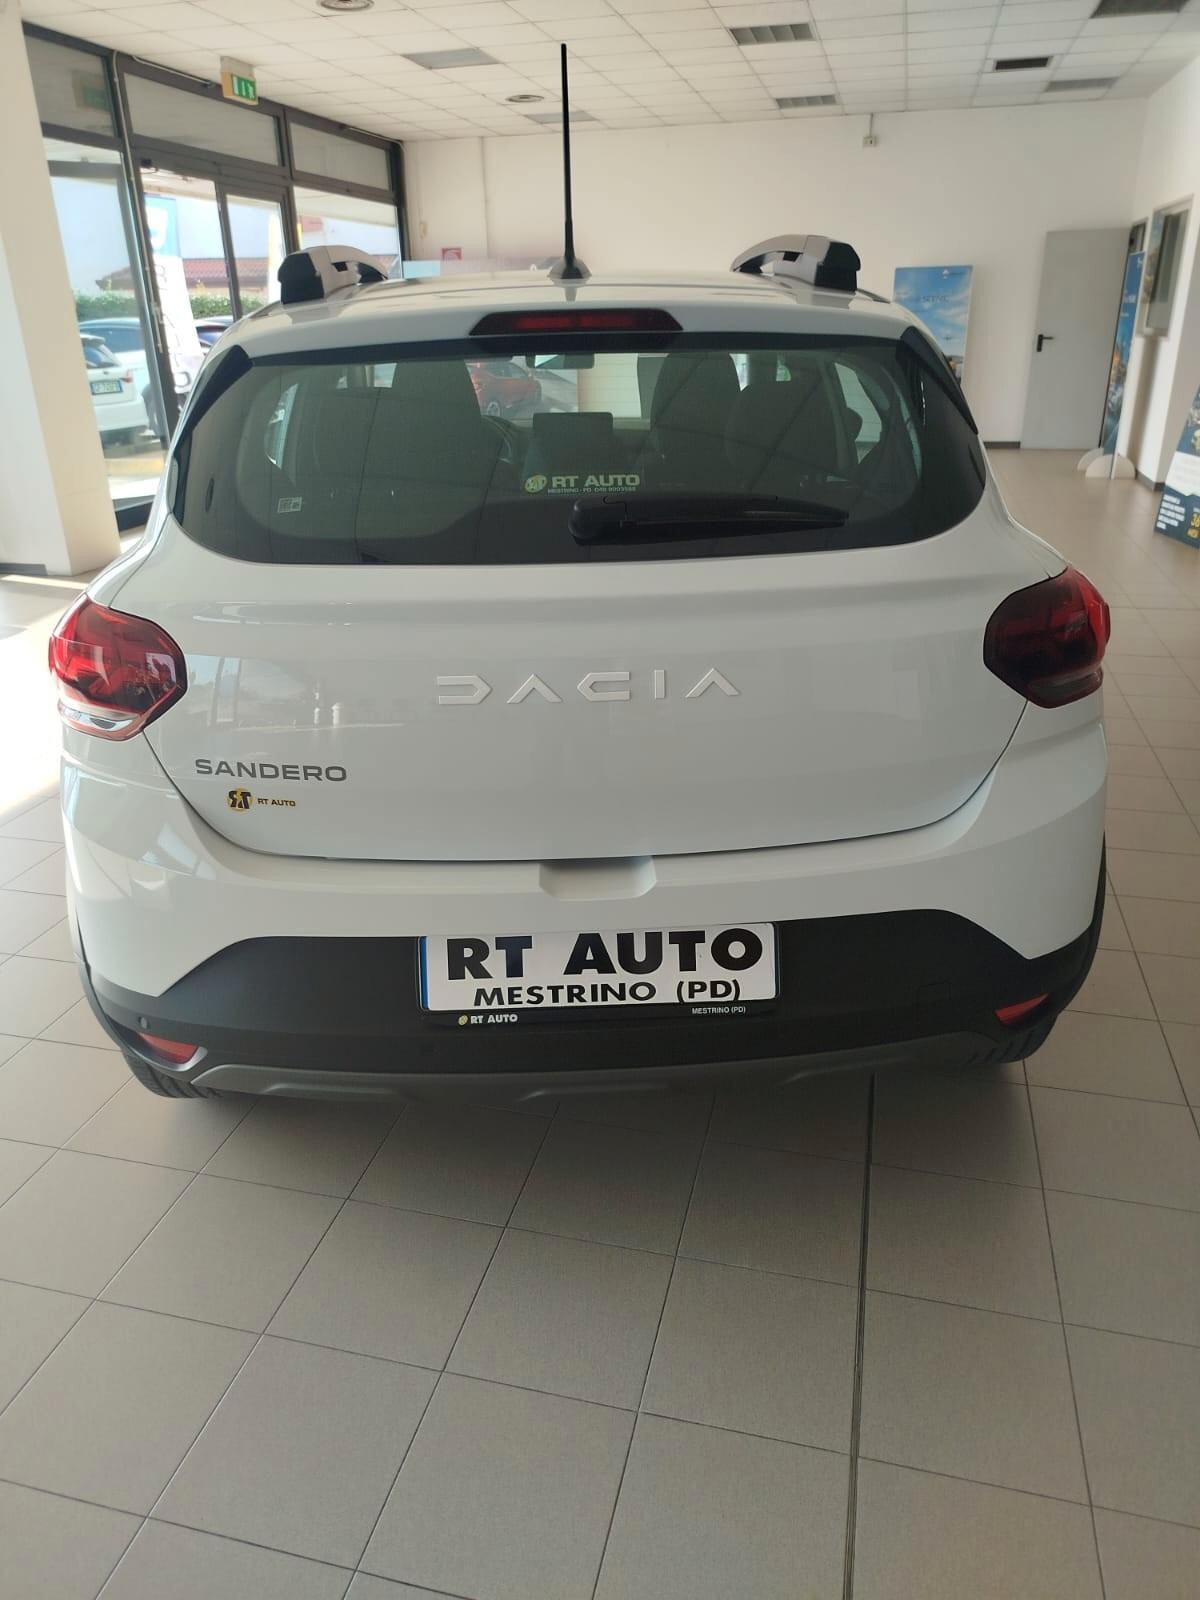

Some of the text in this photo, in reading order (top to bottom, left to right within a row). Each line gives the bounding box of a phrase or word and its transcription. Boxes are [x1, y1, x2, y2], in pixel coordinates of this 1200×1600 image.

[551, 474, 640, 488] RT AUTO
[436, 667, 741, 705] DACIA
[195, 758, 348, 782] SANDERO
[257, 798, 296, 807] RT AUTO
[447, 928, 763, 980] RT AUTO
[473, 979, 741, 1007] MESTRINO (PD)
[470, 1013, 519, 1025] RT AUTO
[692, 1006, 747, 1015] MESTRINO (PD)
